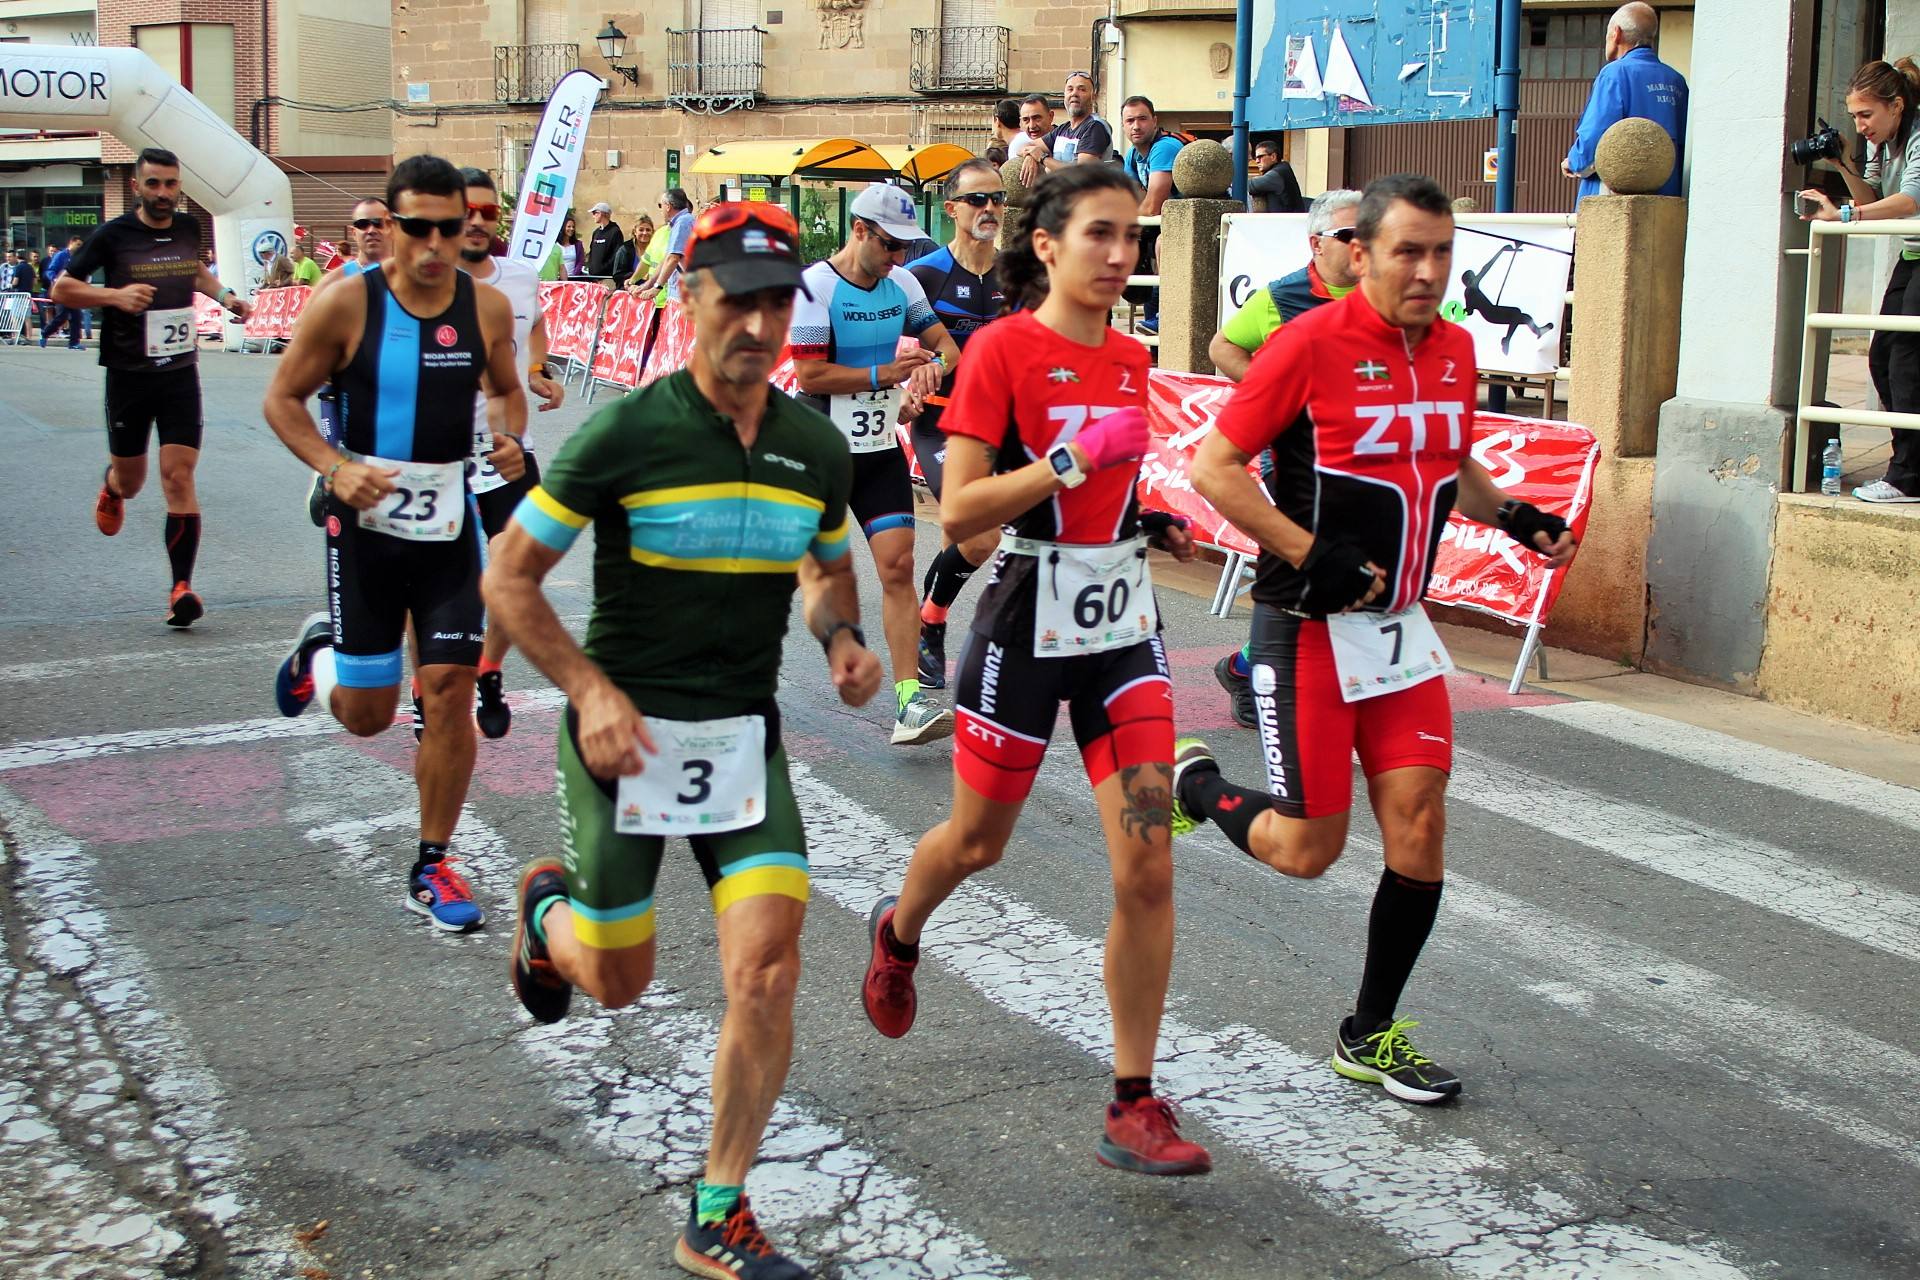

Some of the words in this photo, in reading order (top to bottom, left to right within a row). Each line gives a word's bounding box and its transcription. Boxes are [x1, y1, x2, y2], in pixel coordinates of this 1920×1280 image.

[0, 68, 107, 100] MOTOR
[522, 104, 576, 260] CLOVER
[843, 310, 876, 322] WORLD
[877, 304, 902, 320] SERIES
[164, 322, 189, 345] 29
[424, 352, 446, 360] RIOJA
[447, 351, 472, 360] MOTOR
[851, 410, 886, 437] 33
[1353, 401, 1465, 455] ZTT
[388, 487, 439, 521] 23
[330, 547, 341, 588] RIOJA
[332, 591, 343, 645] MOTOR
[1073, 578, 1129, 629] 60
[432, 632, 464, 641] Audi
[1380, 621, 1402, 666] 7
[980, 641, 1004, 714] ZUMAIA
[966, 718, 1005, 749] ZTT
[677, 758, 714, 806] 3
